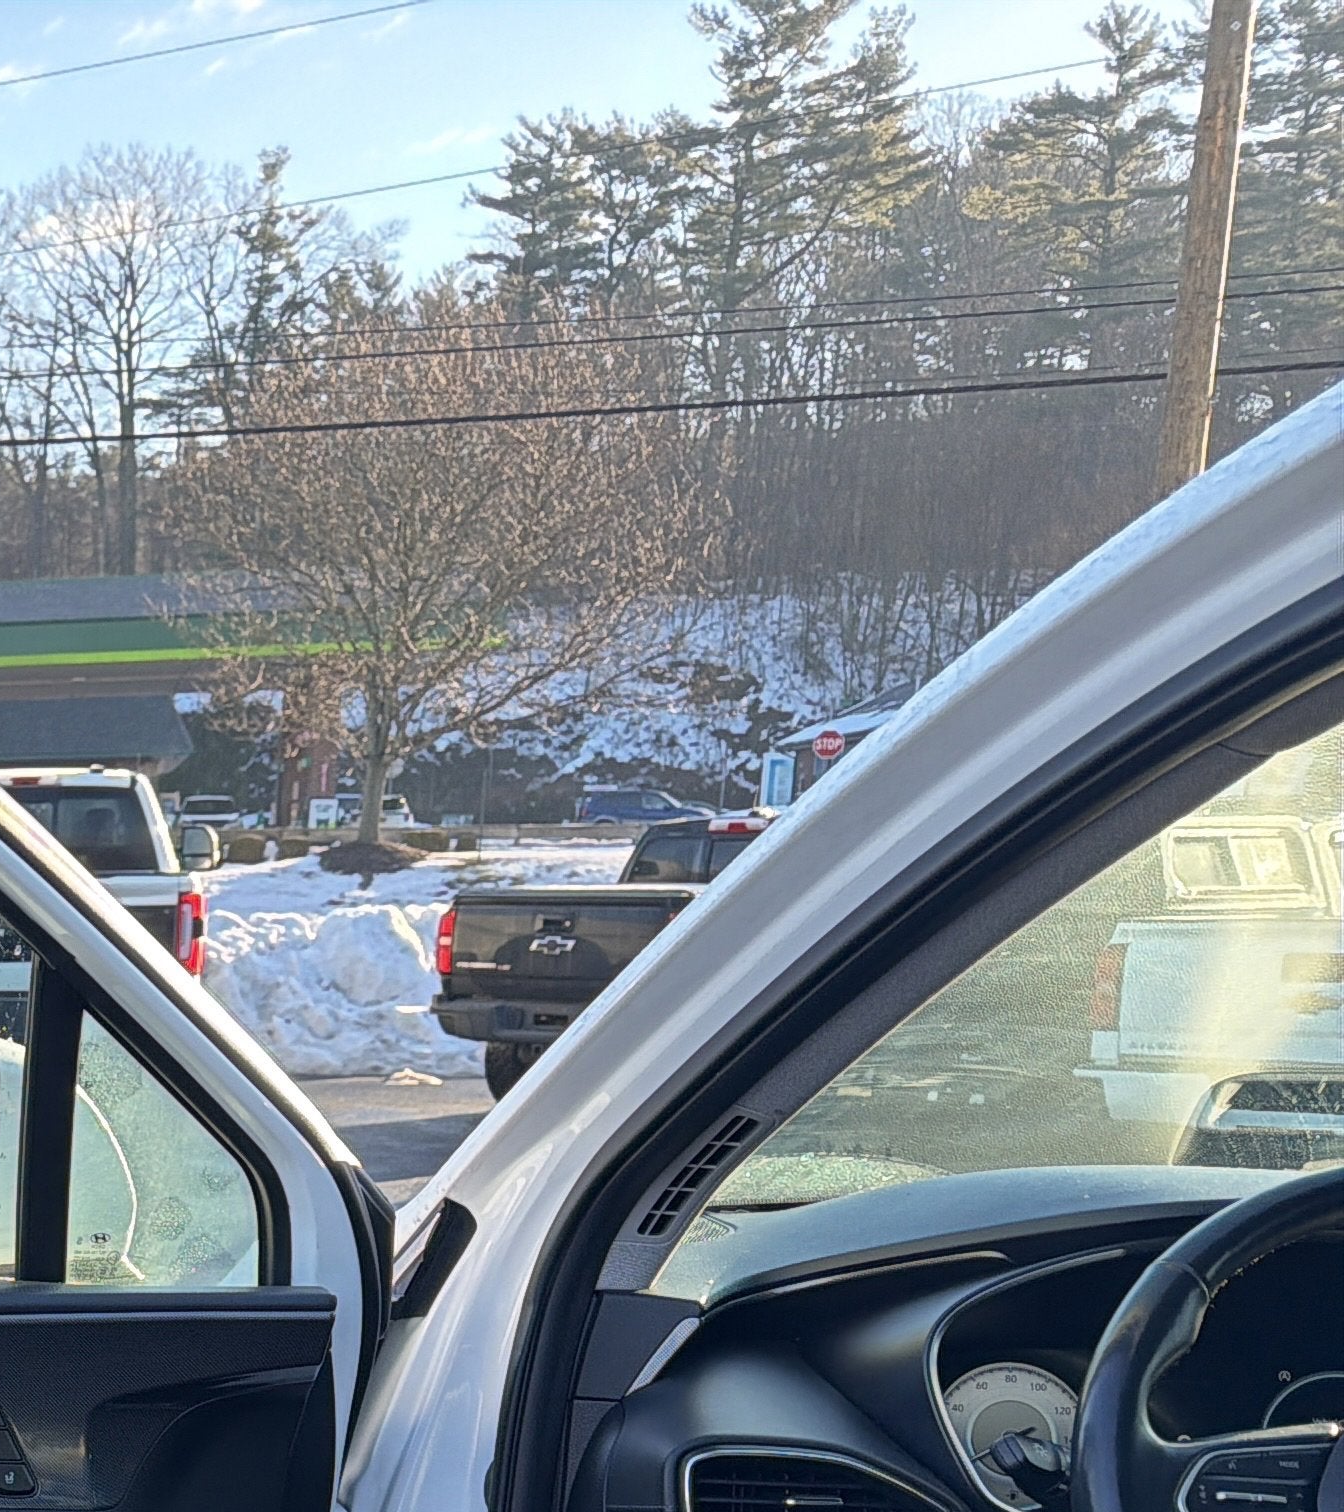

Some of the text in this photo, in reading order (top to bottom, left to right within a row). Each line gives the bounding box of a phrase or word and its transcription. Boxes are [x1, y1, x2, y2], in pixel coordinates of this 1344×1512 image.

[816, 737, 842, 750] STOP
[1004, 1374, 1018, 1384] 80
[975, 1381, 988, 1391] 60
[1030, 1382, 1047, 1392] 100
[951, 1403, 964, 1413] 40
[1054, 1406, 1072, 1416] 120
